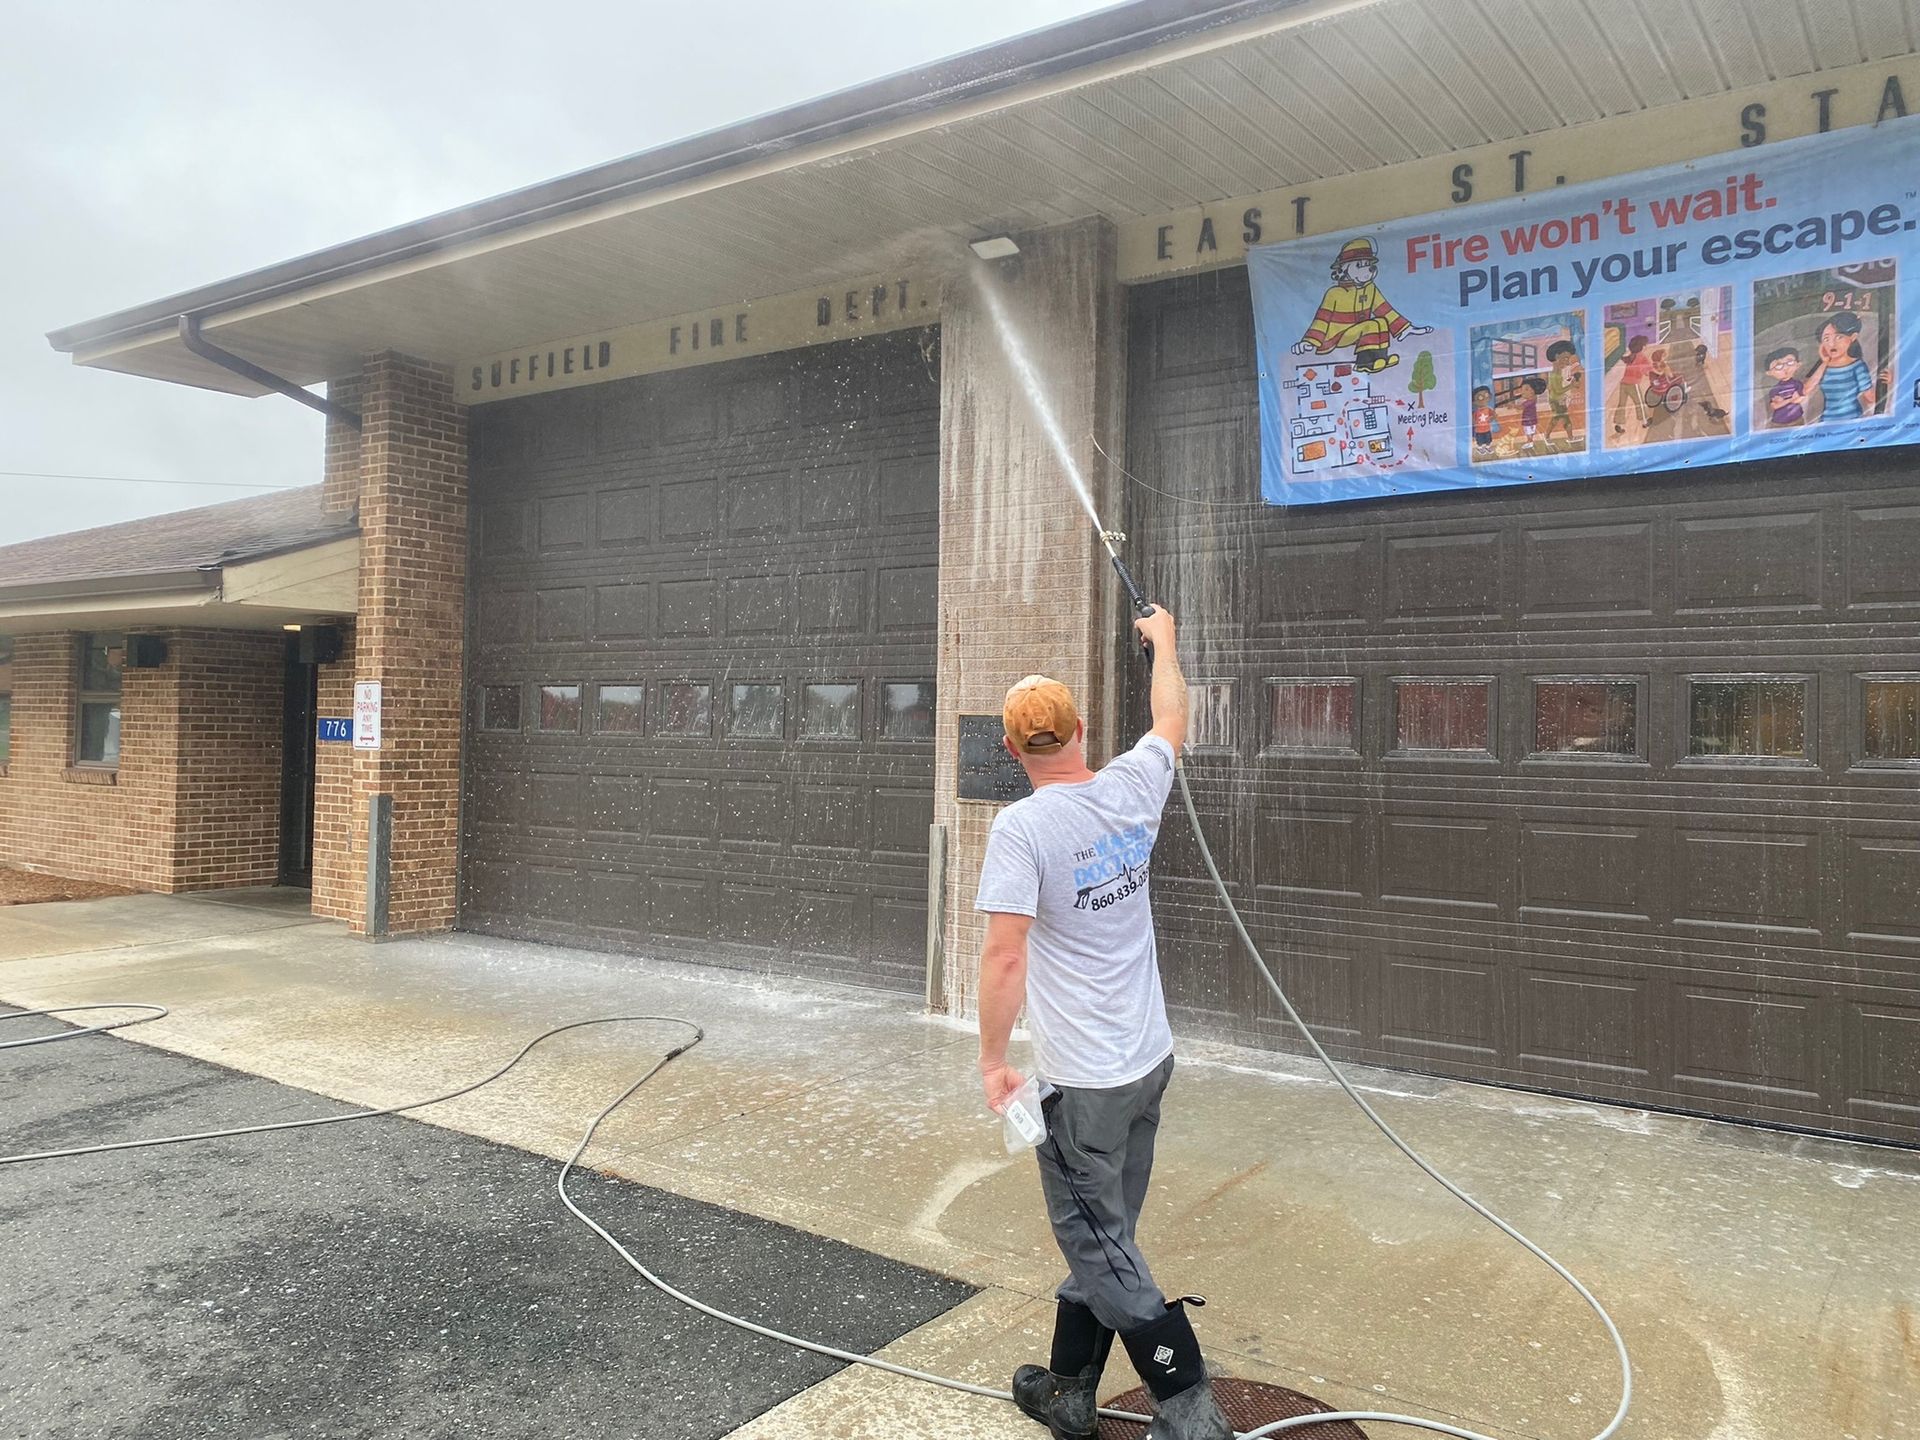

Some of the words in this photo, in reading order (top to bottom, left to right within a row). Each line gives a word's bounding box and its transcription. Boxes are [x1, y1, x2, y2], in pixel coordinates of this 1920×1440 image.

[1156, 196, 1311, 260] EAST
[1451, 150, 1565, 203] ST.
[1741, 75, 1907, 147] STA
[1406, 233, 1490, 274] Fire
[1501, 197, 1637, 256] won't
[1650, 172, 1778, 229] wait.
[1459, 265, 1558, 308] Plan
[1571, 241, 1688, 299] your
[1701, 203, 1917, 266] escape.
[1822, 292, 1873, 312] 9-1-1
[471, 341, 610, 391] SUFFIELD
[669, 314, 748, 356] FIRE
[817, 280, 928, 327] DEPT.
[1397, 413, 1426, 427] Meeting
[1428, 411, 1448, 424] Place
[364, 688, 372, 700] NO
[357, 701, 378, 713] PARKING
[326, 720, 347, 737] 776
[1073, 847, 1096, 862] THE
